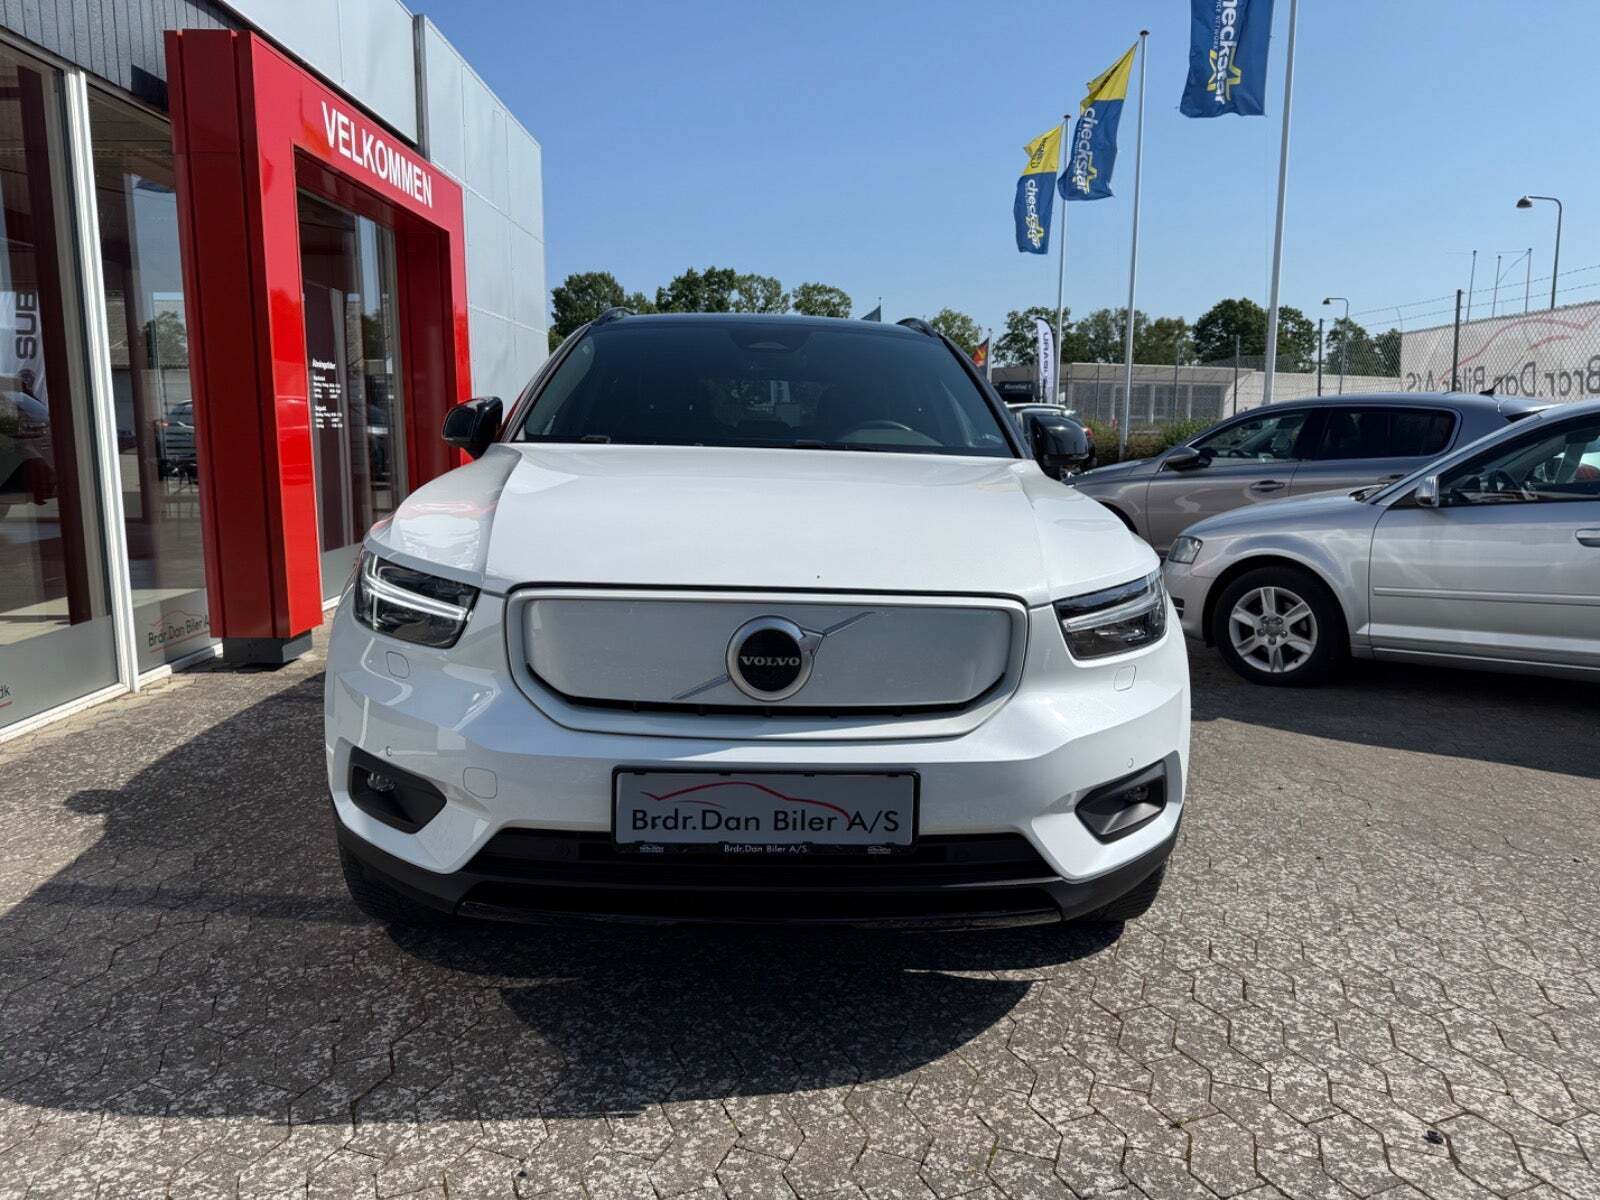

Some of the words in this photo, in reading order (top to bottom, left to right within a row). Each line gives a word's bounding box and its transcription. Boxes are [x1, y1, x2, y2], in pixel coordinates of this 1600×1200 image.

[321, 100, 433, 209] VELKOMMEN
[1076, 107, 1098, 194] checkstar
[740, 655, 801, 667] VOLVO
[632, 808, 760, 831] Brdr.Dan
[774, 809, 838, 831] Biler
[846, 810, 899, 834] A/S
[766, 844, 786, 853] Biler
[788, 844, 808, 854] A/S
